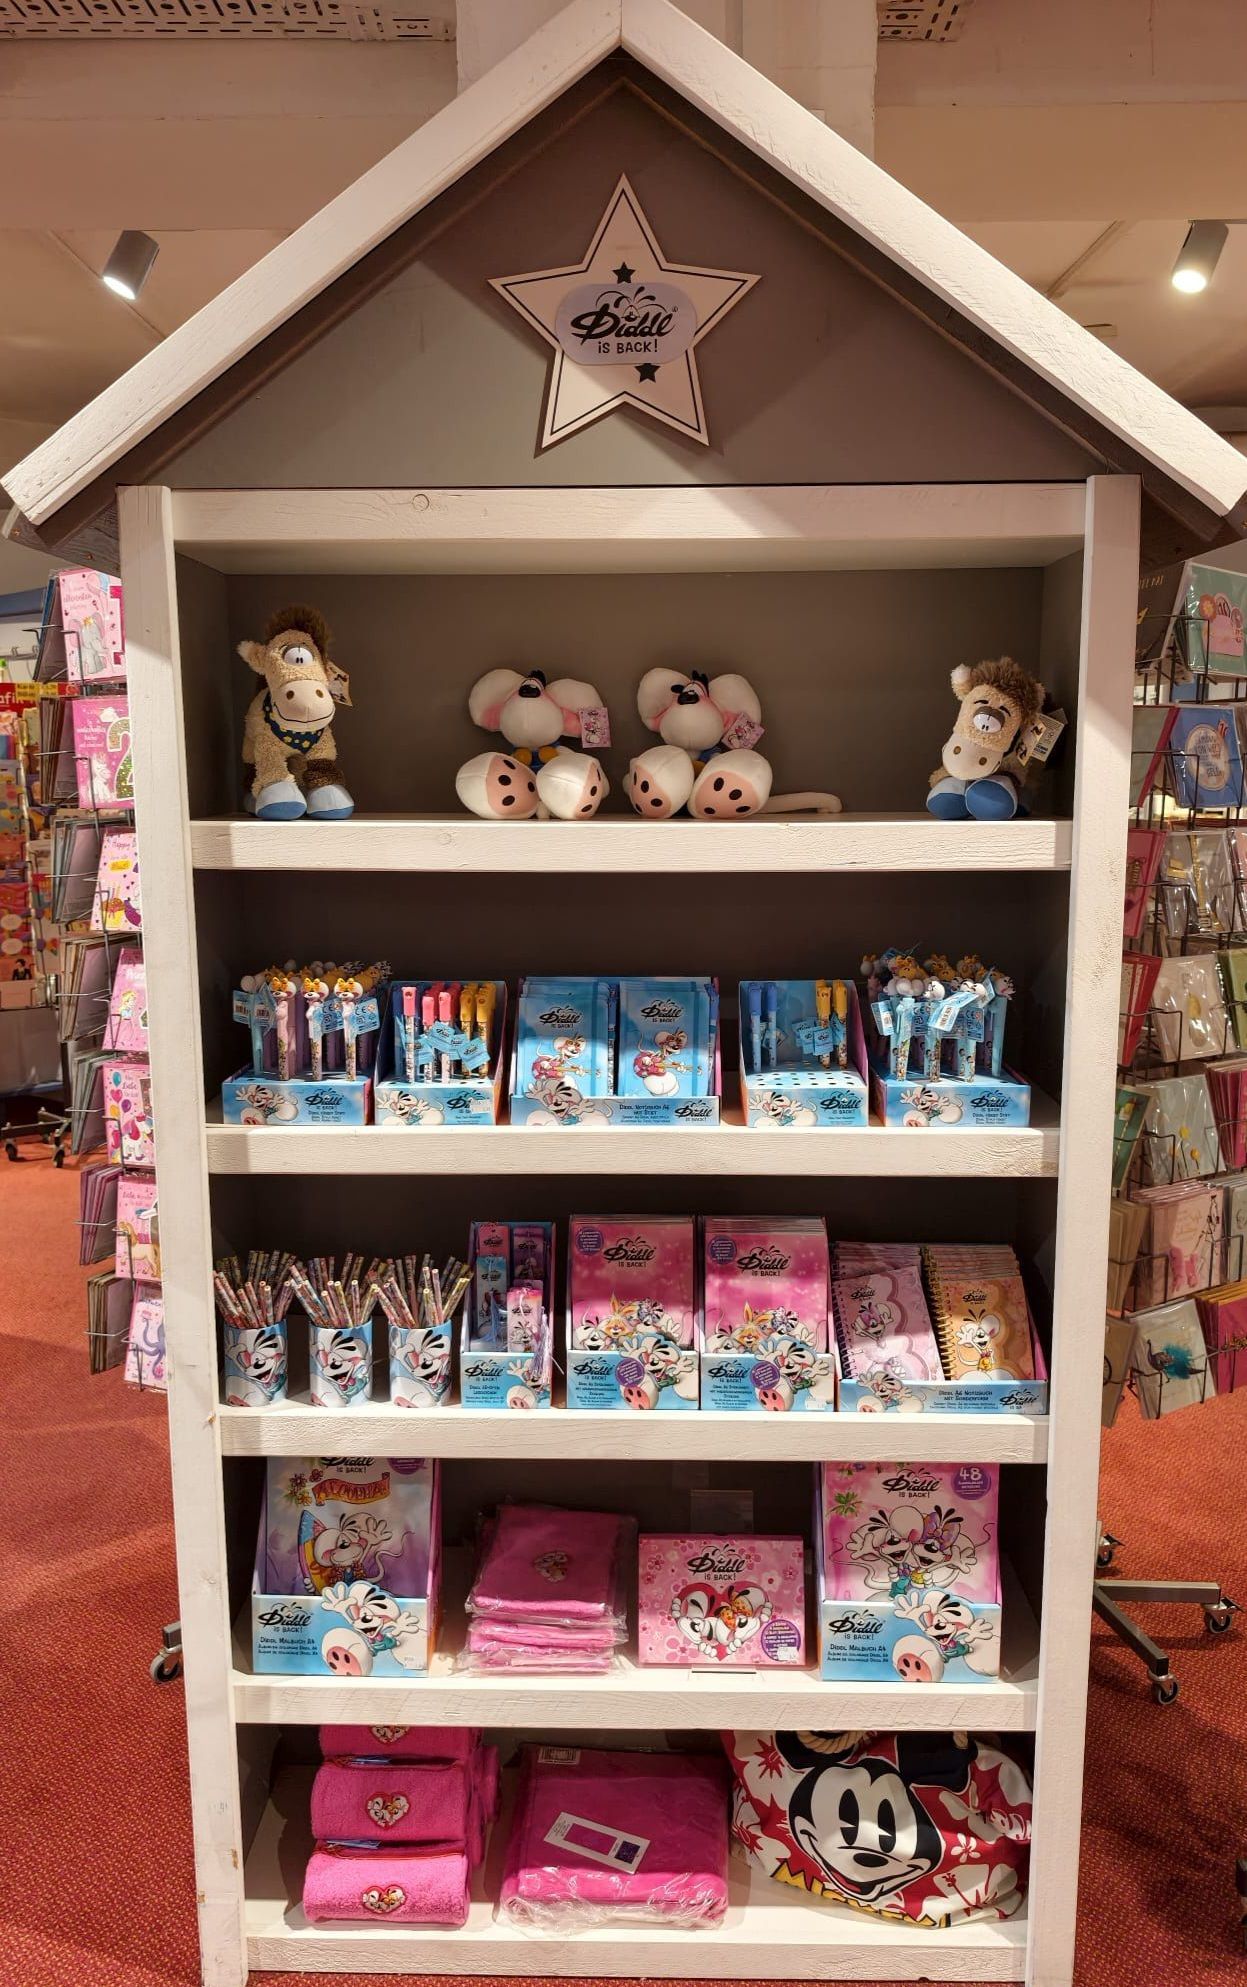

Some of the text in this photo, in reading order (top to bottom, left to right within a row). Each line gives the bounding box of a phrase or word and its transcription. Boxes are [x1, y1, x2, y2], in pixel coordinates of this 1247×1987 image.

[570, 303, 676, 345] Diddl
[617, 339, 658, 353] BACK!
[539, 1010, 581, 1024] Diddl
[640, 1004, 683, 1019] Diddl
[820, 1096, 862, 1111] Diddl
[970, 1095, 1009, 1108] Diddl
[675, 1104, 713, 1118] Diddl
[603, 1244, 655, 1263] Diddl
[737, 1253, 790, 1273] Diddl
[464, 1365, 504, 1378] Diddl
[573, 1362, 613, 1376] Diddl
[707, 1365, 750, 1379] Diddl
[960, 1467, 982, 1481] 48
[882, 1475, 940, 1493] Diddl
[687, 1553, 746, 1576] Diddl
[257, 1609, 311, 1628] Diddl
[828, 1616, 884, 1635] Diddl
